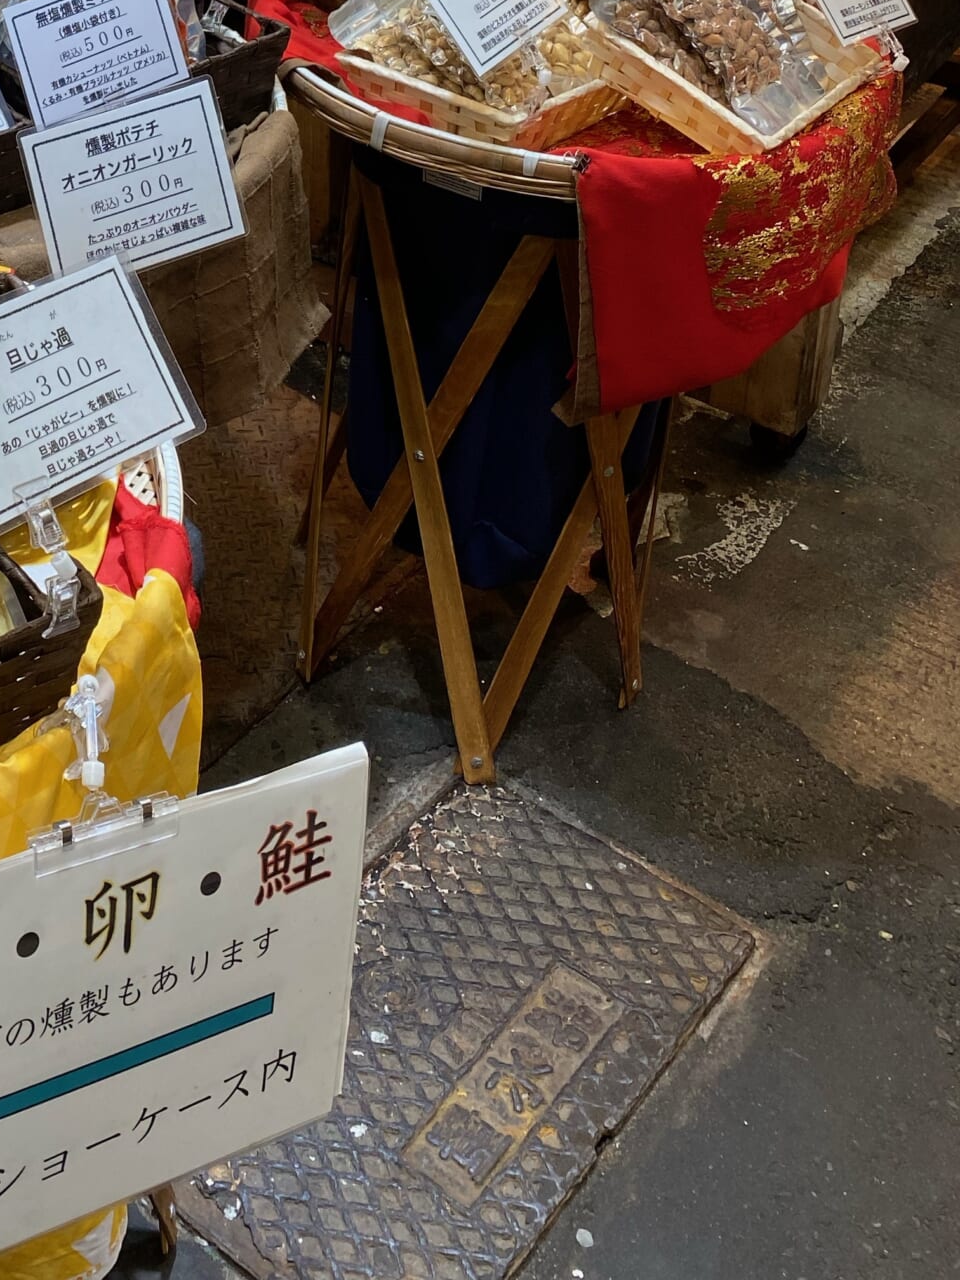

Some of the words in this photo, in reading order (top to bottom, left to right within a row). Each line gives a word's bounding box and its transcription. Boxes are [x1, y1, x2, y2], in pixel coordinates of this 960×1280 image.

[85, 120, 159, 156] 燻製ポテチ
[61, 137, 193, 191] オニオンガーリック
[88, 202, 198, 245] たっぷりのオニオンパウダー
[6, 327, 73, 368] 旦じゃ過
[39, 413, 116, 457] 旦過の旦じゃ過で
[47, 431, 122, 476] 旦じゃ過ろーや！
